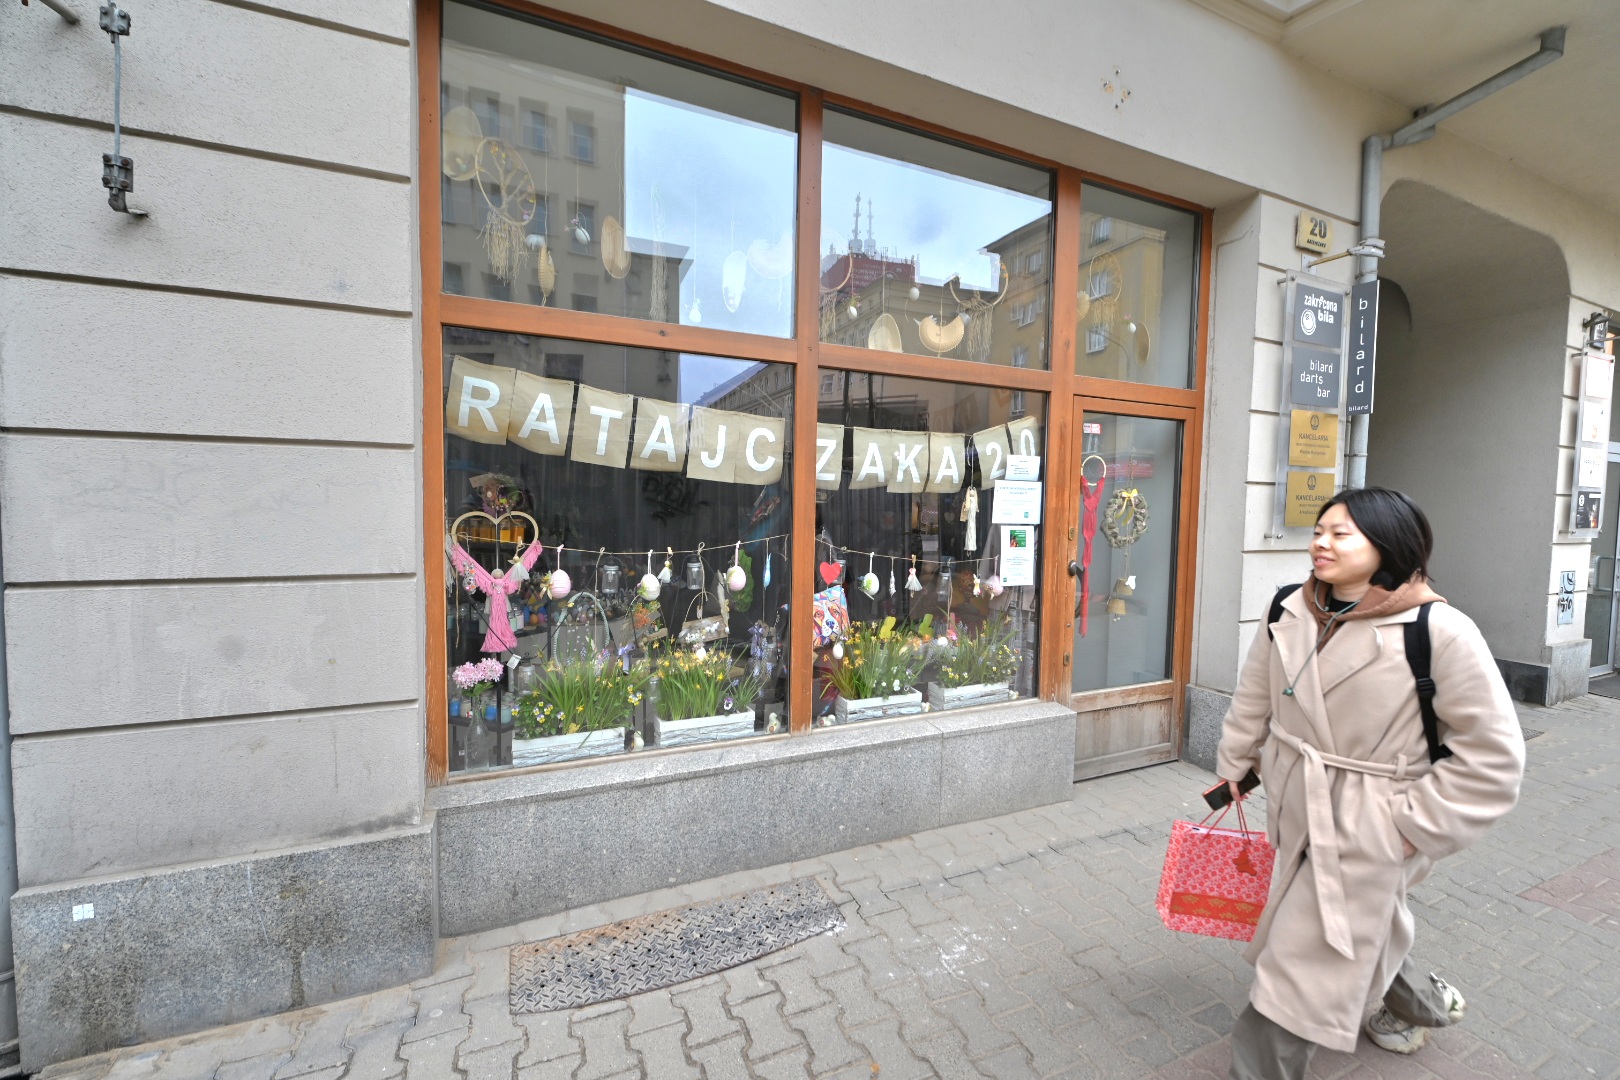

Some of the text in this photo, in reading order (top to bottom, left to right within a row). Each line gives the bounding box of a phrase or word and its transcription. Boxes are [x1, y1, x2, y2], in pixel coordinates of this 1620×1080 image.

[1310, 217, 1327, 239] 20
[1318, 309, 1334, 324] bila
[1355, 298, 1368, 393] bilard
[1310, 359, 1333, 374] bilard
[1300, 371, 1323, 385] darts
[1317, 386, 1331, 398] bar
[1348, 404, 1369, 412] bilard
[1298, 433, 1329, 442] KANCELARIA
[1296, 494, 1326, 502] KANCELARIA
